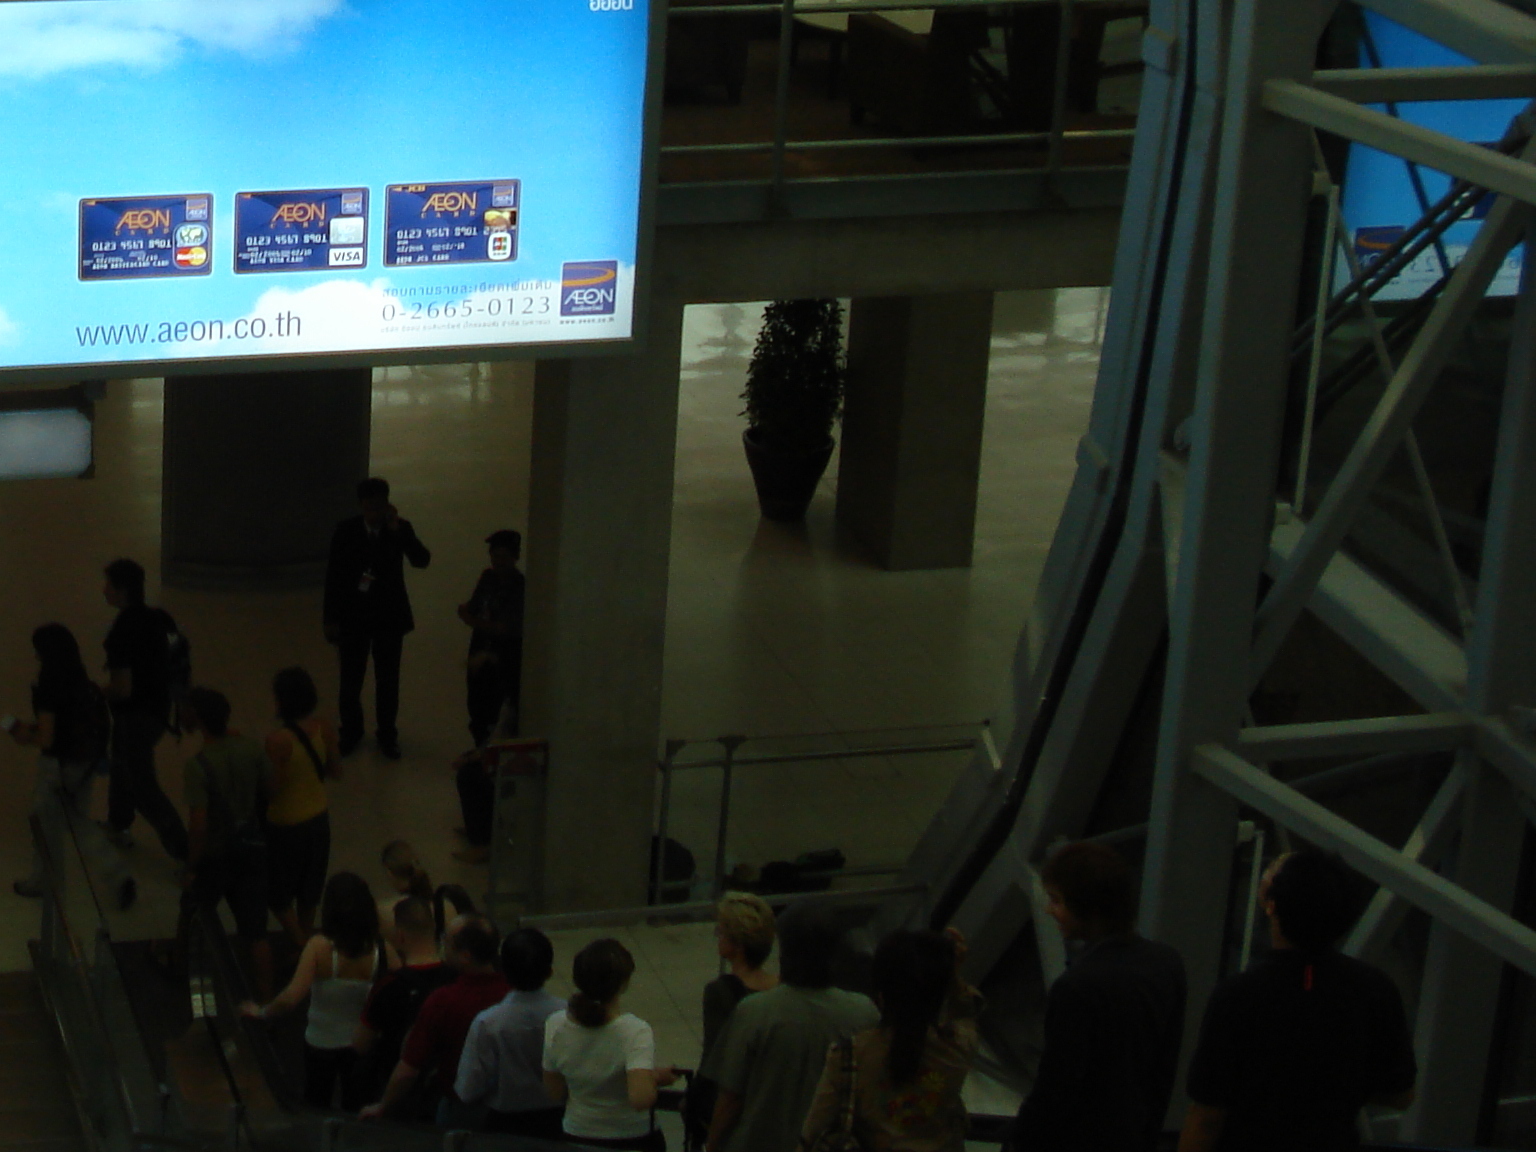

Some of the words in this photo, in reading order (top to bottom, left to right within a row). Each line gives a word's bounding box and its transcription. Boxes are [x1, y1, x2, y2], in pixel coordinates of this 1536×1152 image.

[332, 250, 361, 263] VISA
[381, 296, 552, 322] 0-2665-0123
[75, 310, 303, 347] www.aeon.co.th
